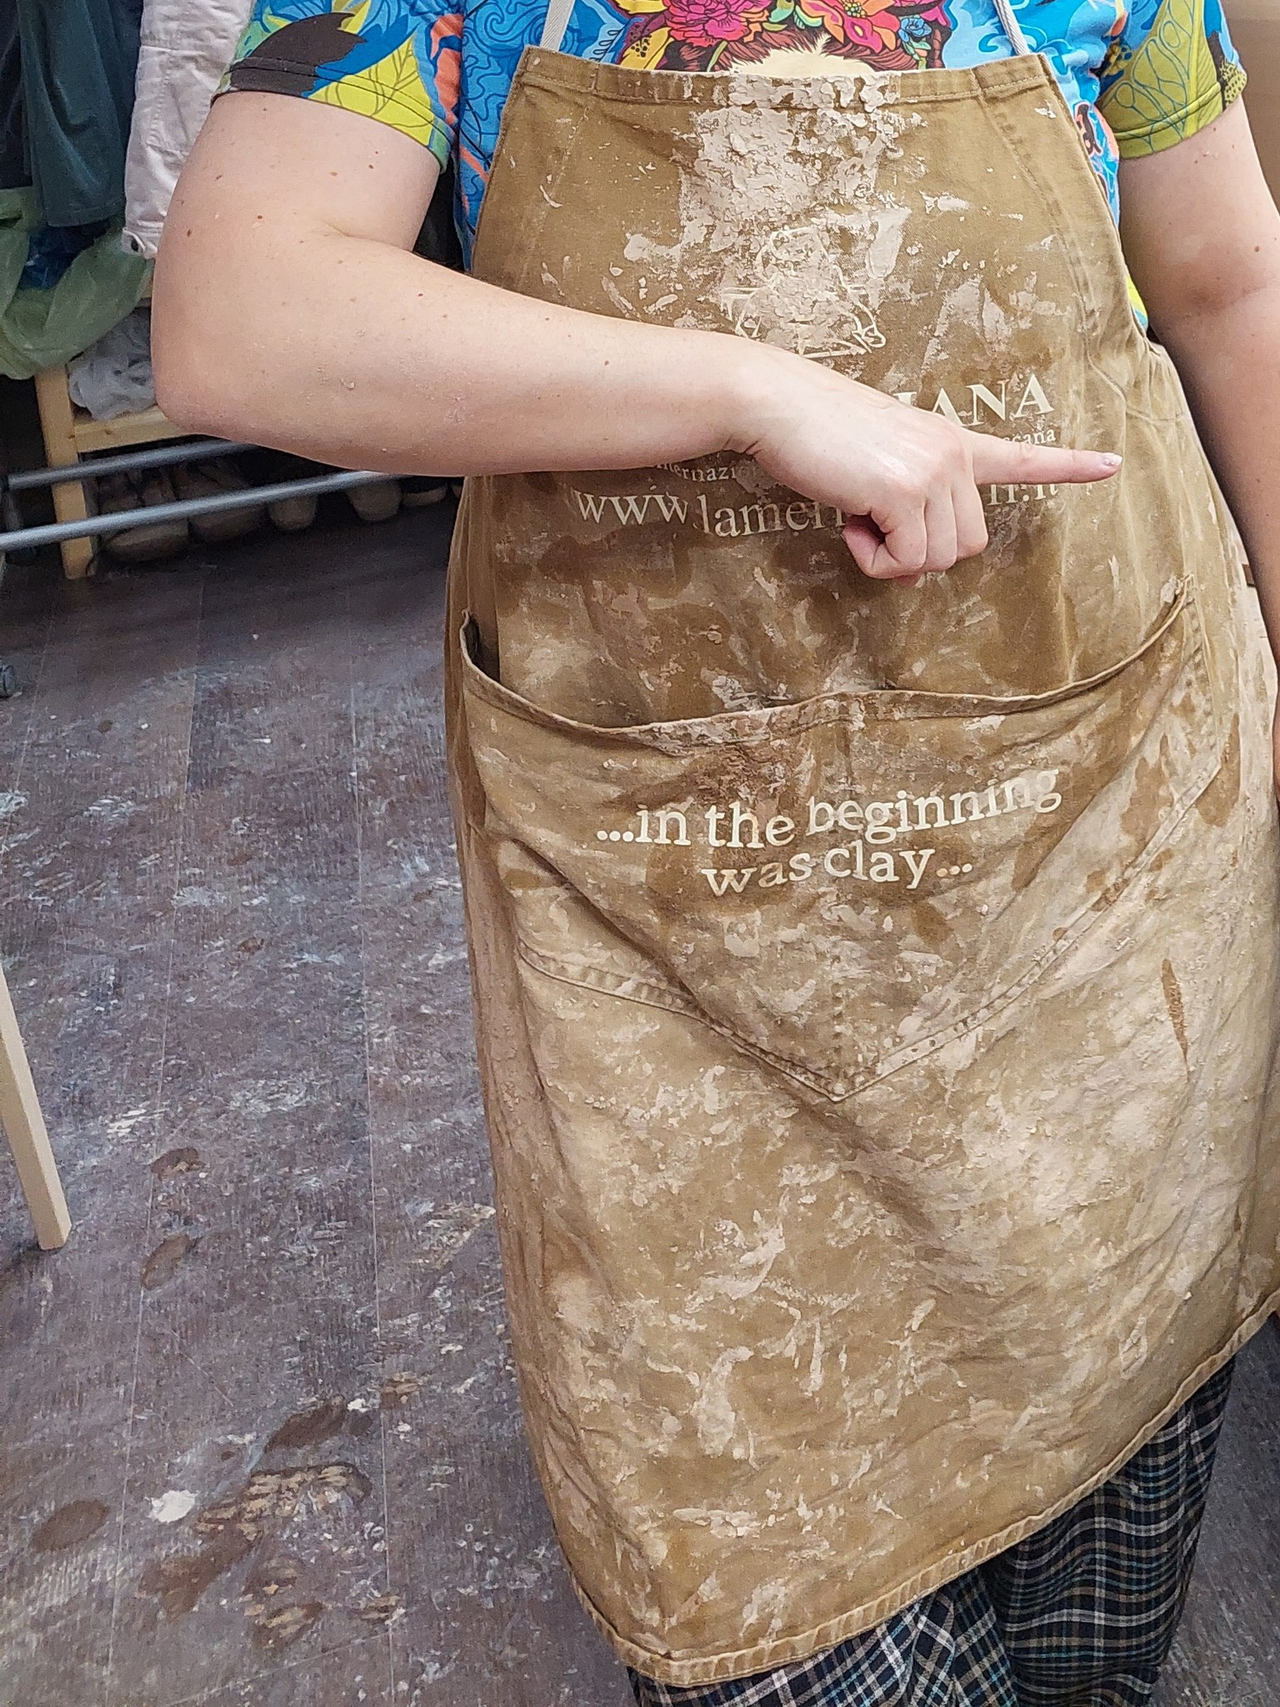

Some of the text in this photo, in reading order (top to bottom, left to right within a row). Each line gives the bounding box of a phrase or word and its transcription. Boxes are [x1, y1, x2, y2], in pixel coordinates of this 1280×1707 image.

[704, 800, 796, 850] the
[805, 768, 1063, 844] beginning
[700, 839, 973, 896] was clay...
